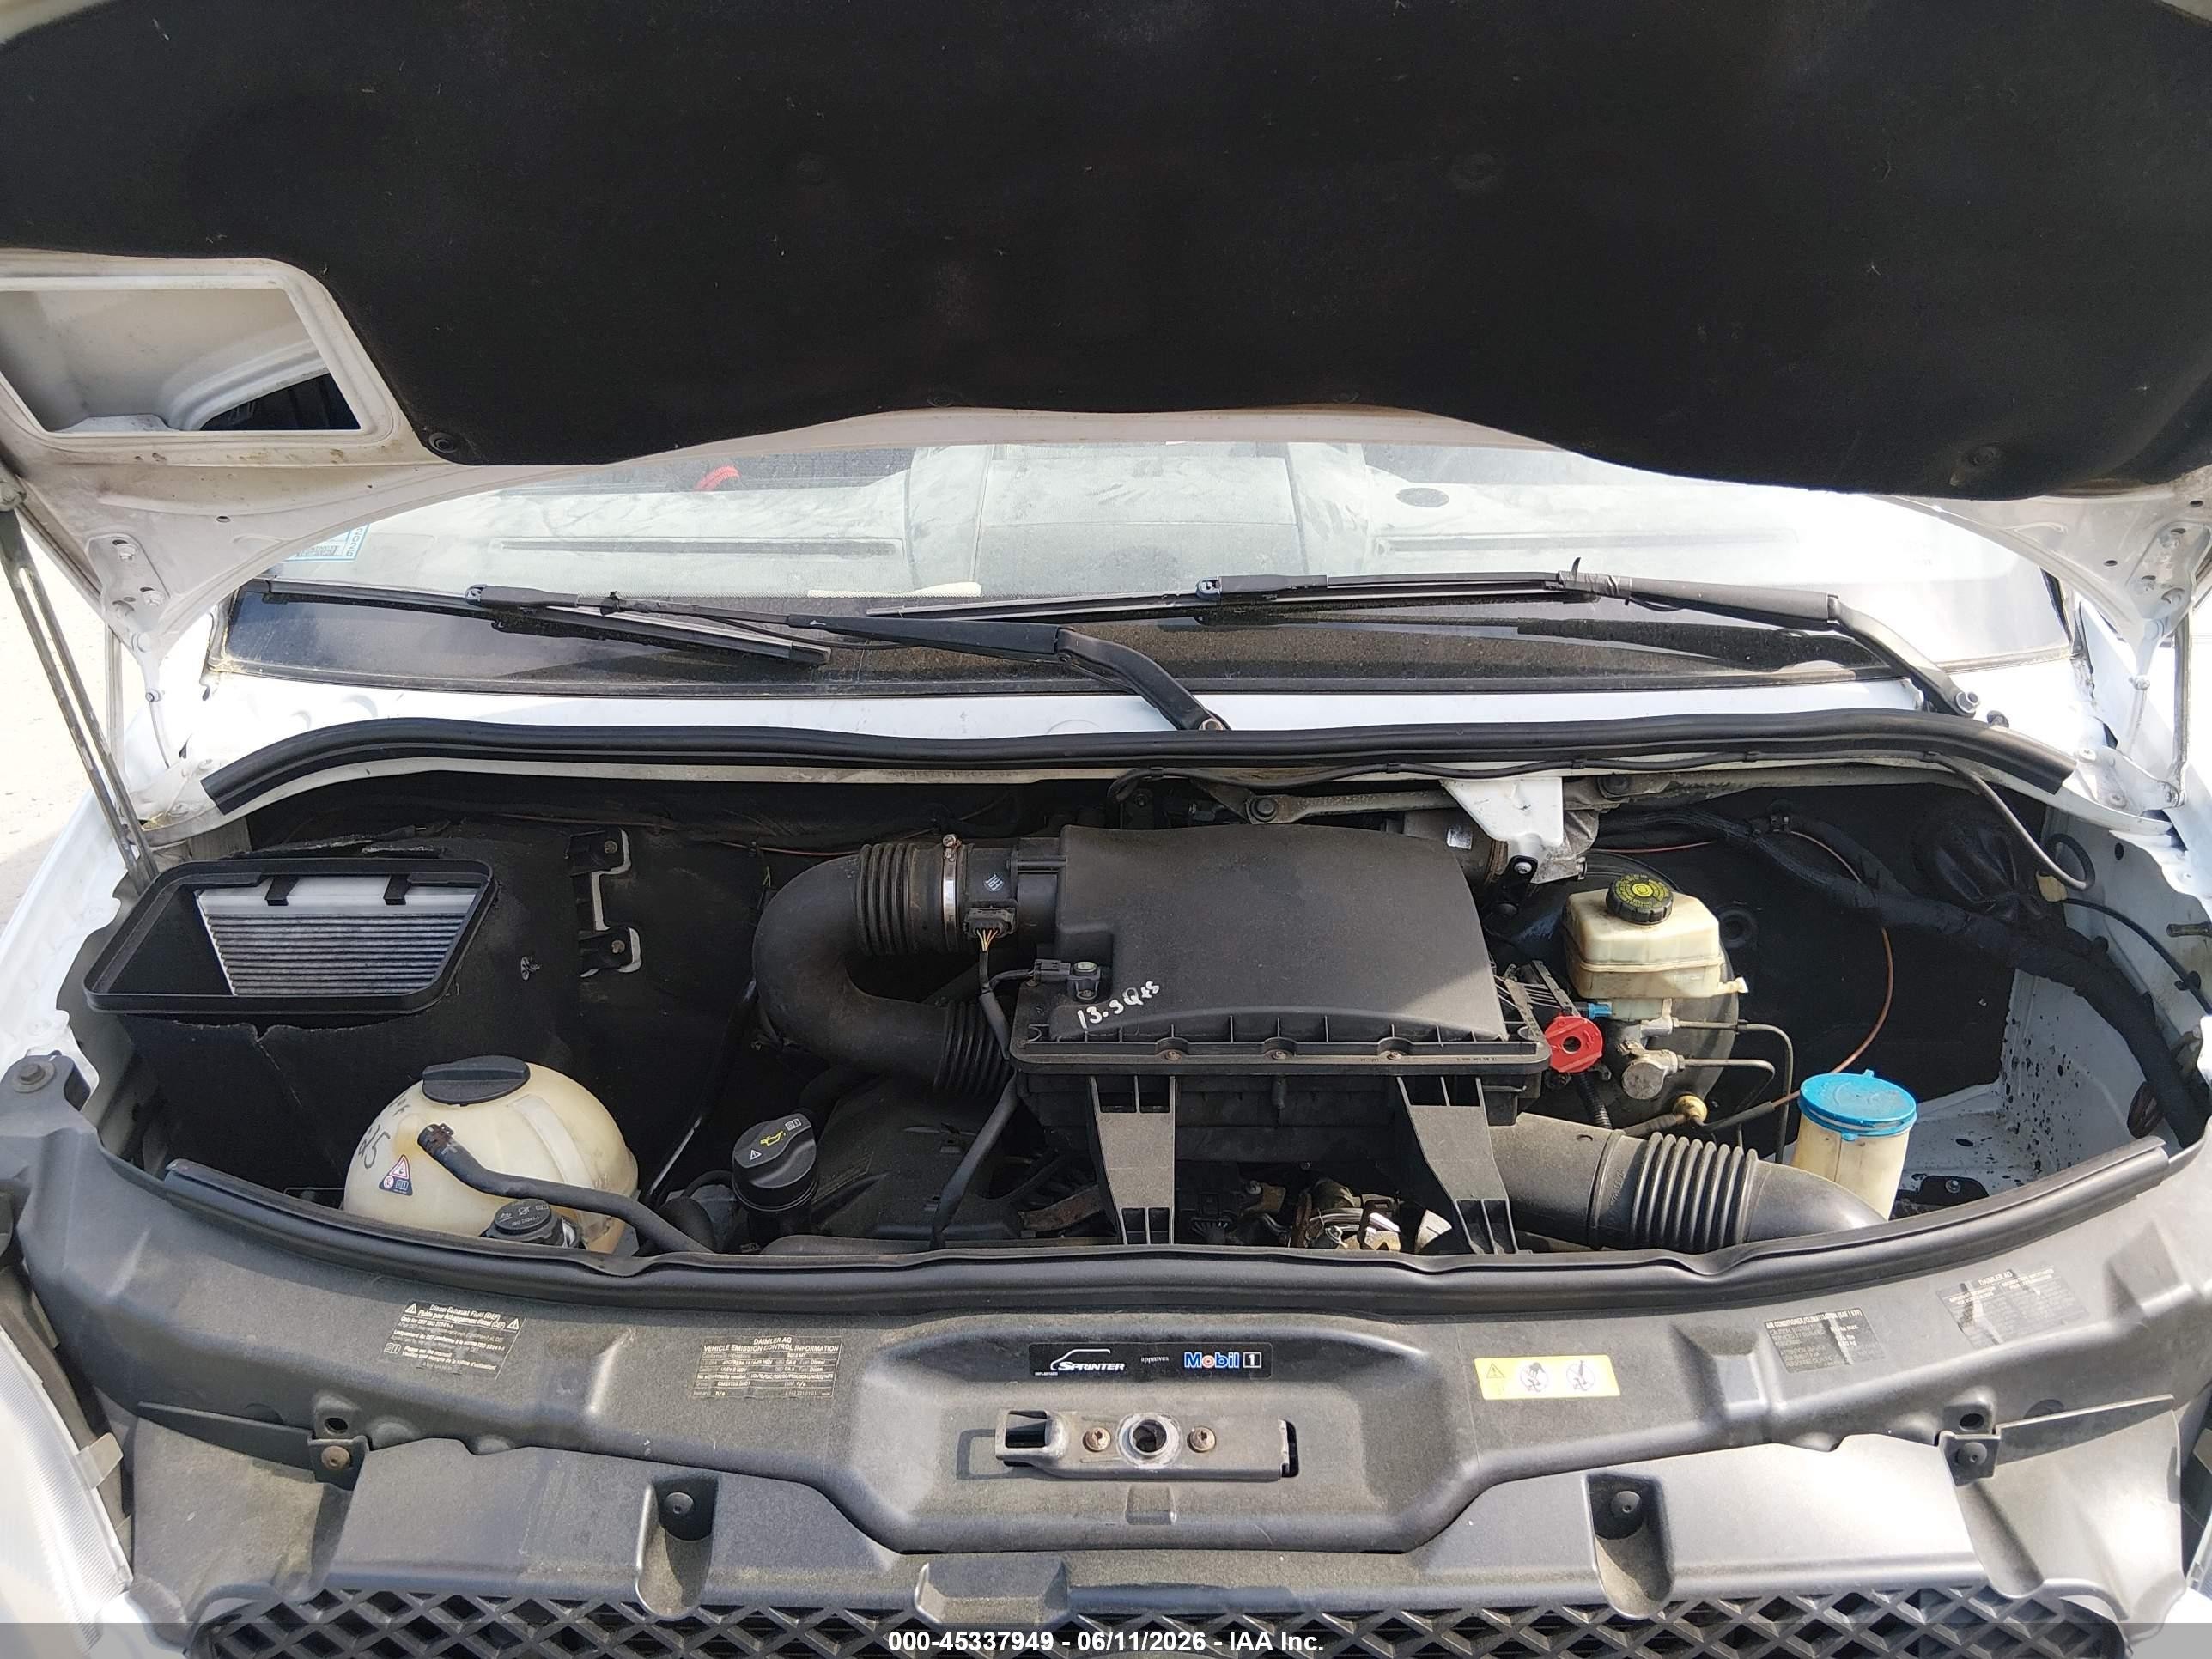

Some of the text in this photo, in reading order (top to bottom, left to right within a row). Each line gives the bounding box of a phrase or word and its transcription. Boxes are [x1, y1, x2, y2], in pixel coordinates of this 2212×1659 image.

[346, 528, 363, 557] 2026
[429, 1304, 447, 1312] Diesel
[447, 1306, 470, 1316] Exhaust
[484, 1311, 501, 1321] (DEF)
[704, 1343, 840, 1352] VEHICLE EMISSION CONTROL INFORMATION
[753, 1337, 781, 1346] DAIMLER
[1057, 1361, 1126, 1371] SPRINTER
[1183, 1352, 1240, 1369] Mobil
